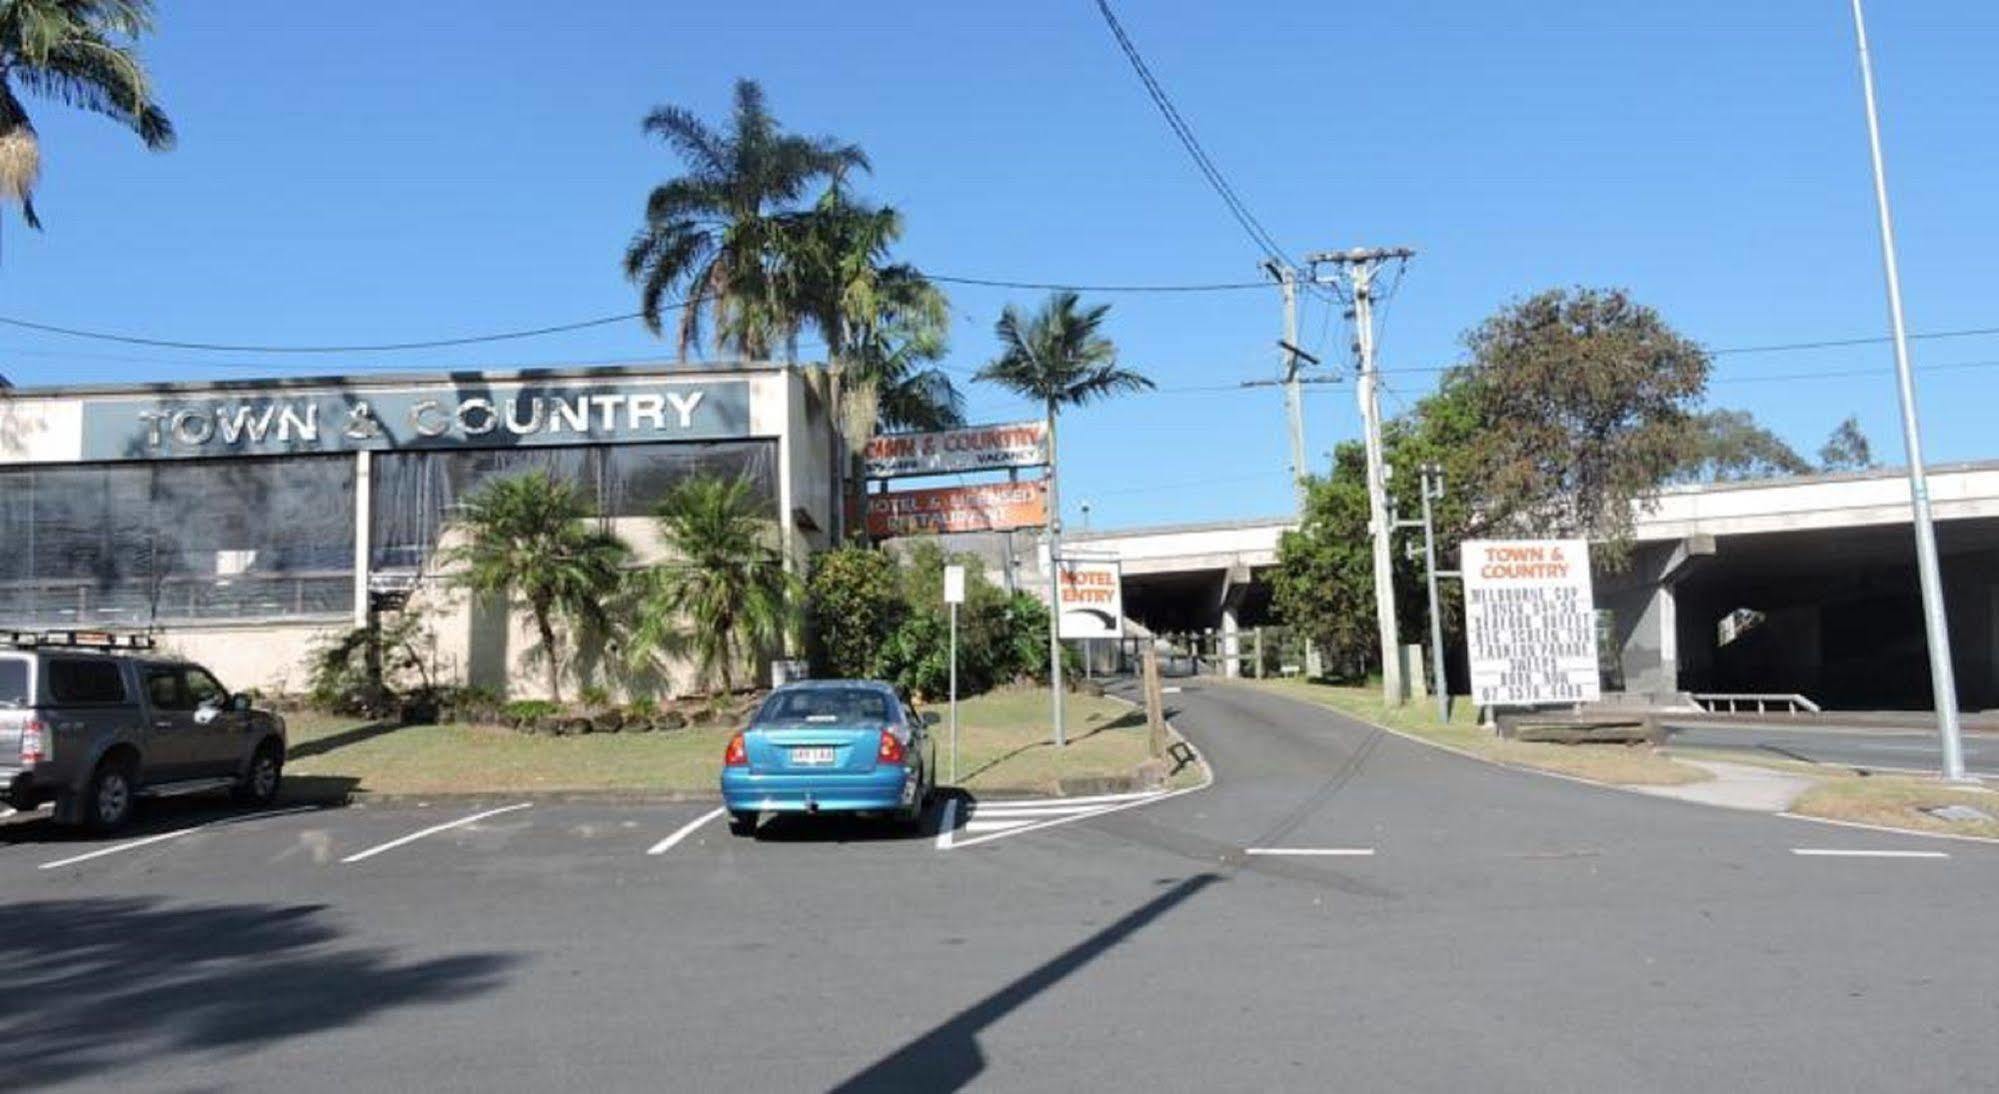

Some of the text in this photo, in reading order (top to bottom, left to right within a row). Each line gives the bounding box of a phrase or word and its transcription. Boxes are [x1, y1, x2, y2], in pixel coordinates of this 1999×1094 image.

[139, 391, 703, 445] TOWN & COUNTRY
[864, 427, 1040, 459] OWN & COUNTRY
[977, 451, 1036, 464] VACANCY
[1484, 546, 1565, 562] TOWN &
[1060, 570, 1116, 585] MOTEL
[1481, 563, 1570, 579] COUNTRY
[1062, 588, 1115, 603] ENTRY
[1471, 586, 1578, 602] MELBOURNE CUP
